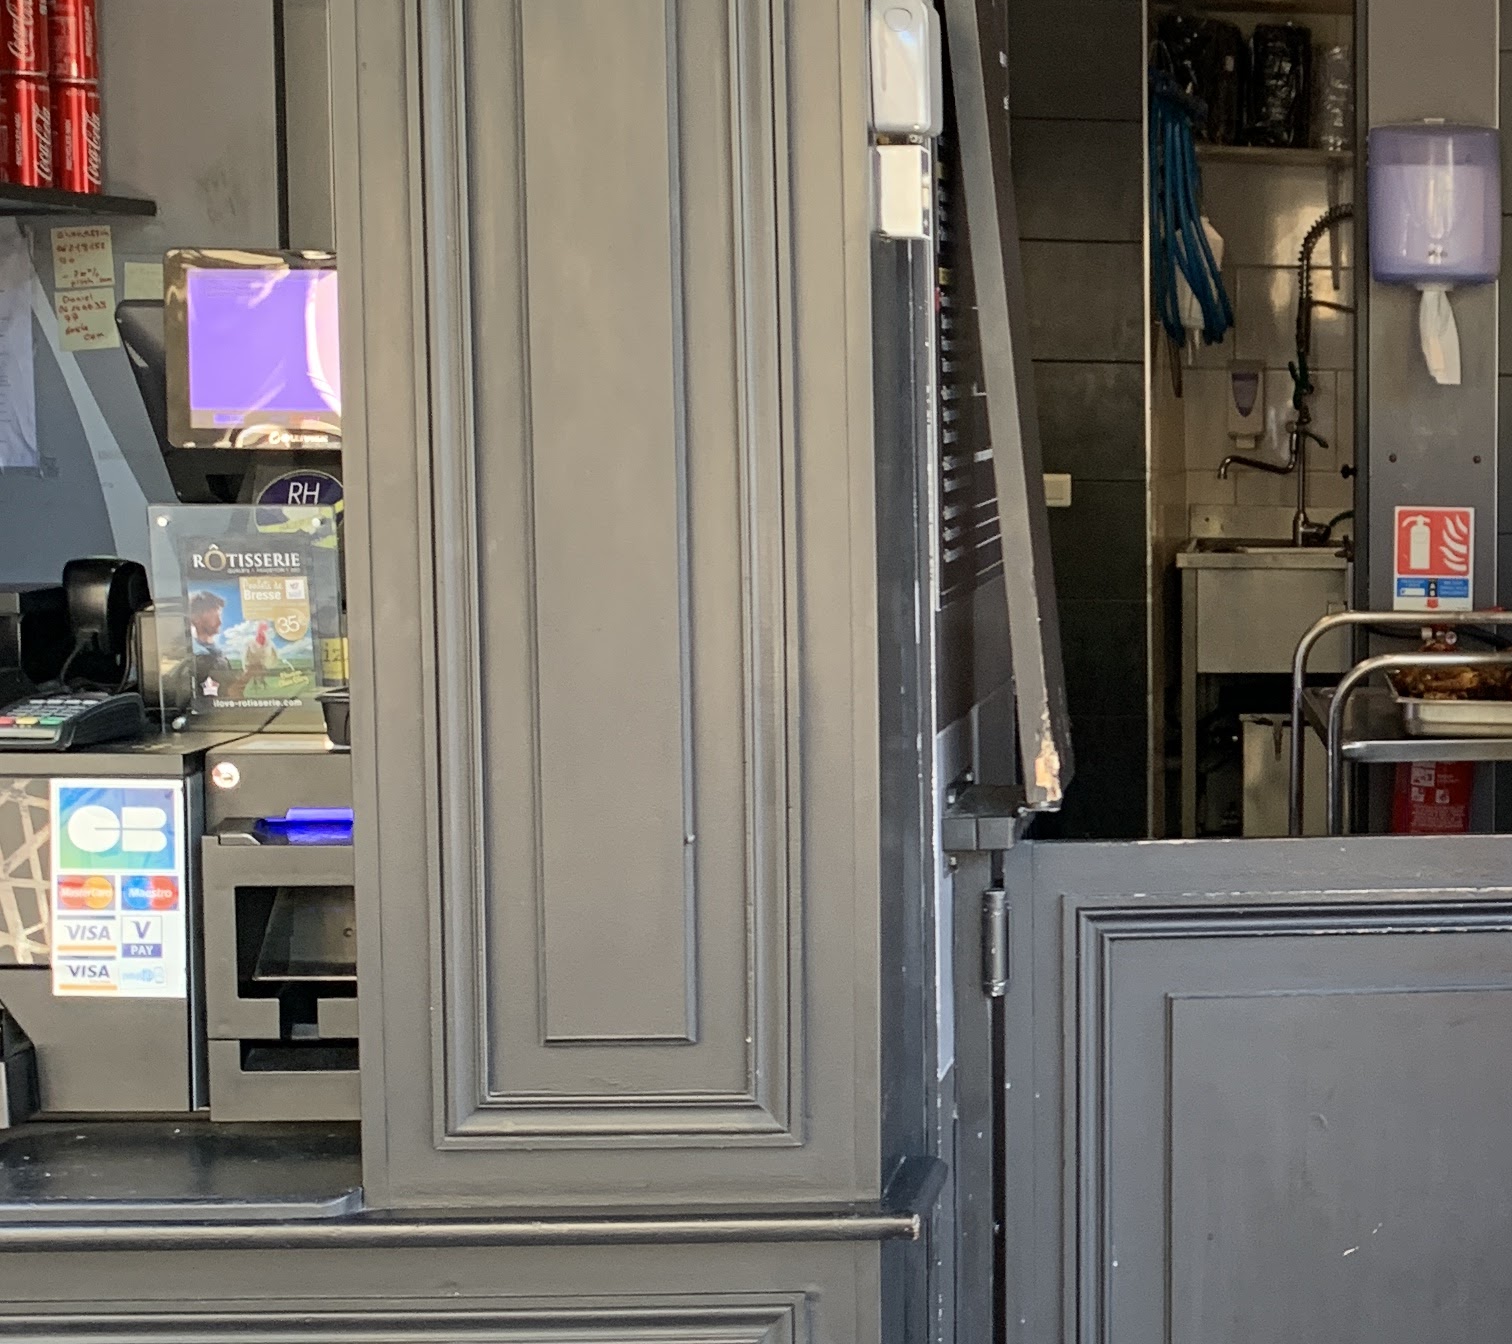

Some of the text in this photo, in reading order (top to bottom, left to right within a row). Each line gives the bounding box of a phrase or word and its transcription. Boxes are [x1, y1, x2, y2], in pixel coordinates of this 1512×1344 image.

[193, 544, 301, 572] RÔTISSERIE
[243, 590, 282, 601] Bresse
[128, 887, 173, 898] Maestro
[64, 924, 112, 941] VISA
[130, 944, 154, 956] PAY
[65, 964, 111, 979] VISA
